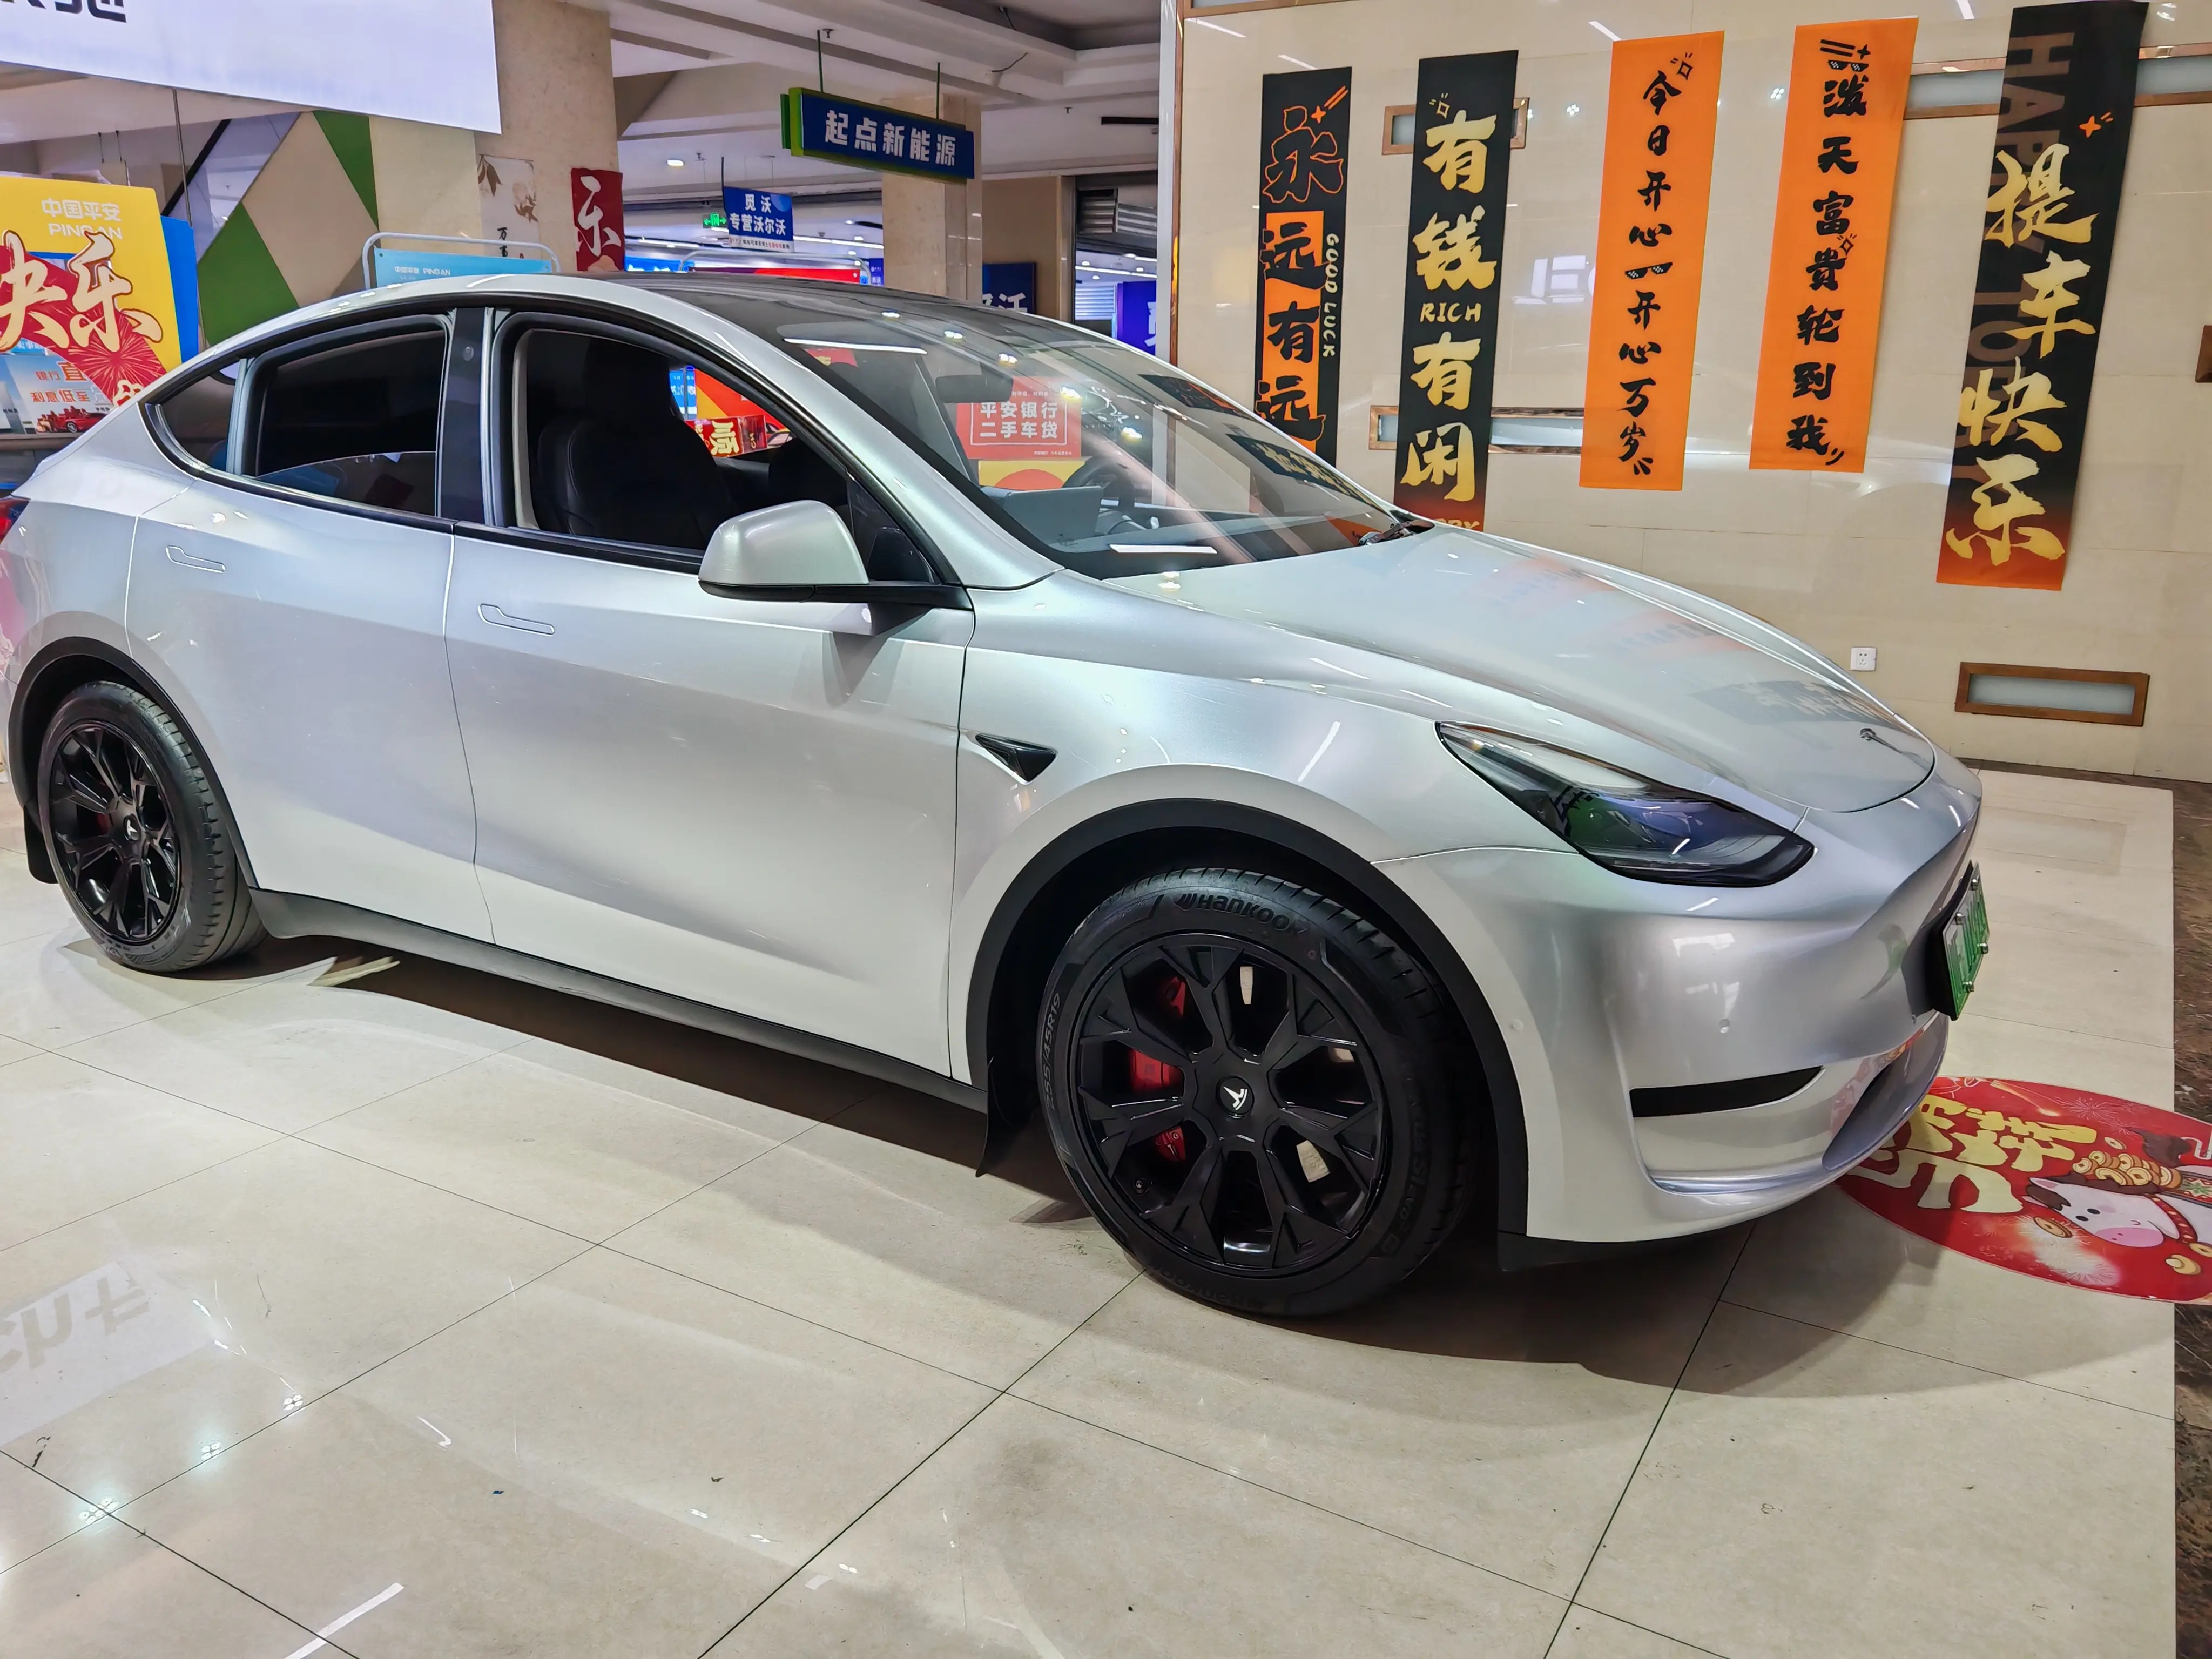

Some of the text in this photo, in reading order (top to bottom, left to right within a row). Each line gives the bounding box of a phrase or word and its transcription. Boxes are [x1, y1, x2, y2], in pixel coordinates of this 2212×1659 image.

[825, 110, 956, 166] 起点新能源
[42, 198, 122, 221] 中国平安
[574, 176, 622, 257] 乐
[730, 212, 786, 236] 专营沃尔沃
[0, 230, 163, 352] 快乐
[1322, 233, 1339, 358] GOOD LUCK
[1786, 76, 1868, 455] 泼天富贵轮到我
[1420, 302, 1481, 323] RICH
[1946, 143, 2098, 566] 提车快乐
[980, 401, 1058, 419] 平安银行
[980, 421, 1058, 439] 二手车贷
[1043, 993, 1061, 1111] 255/45R19
